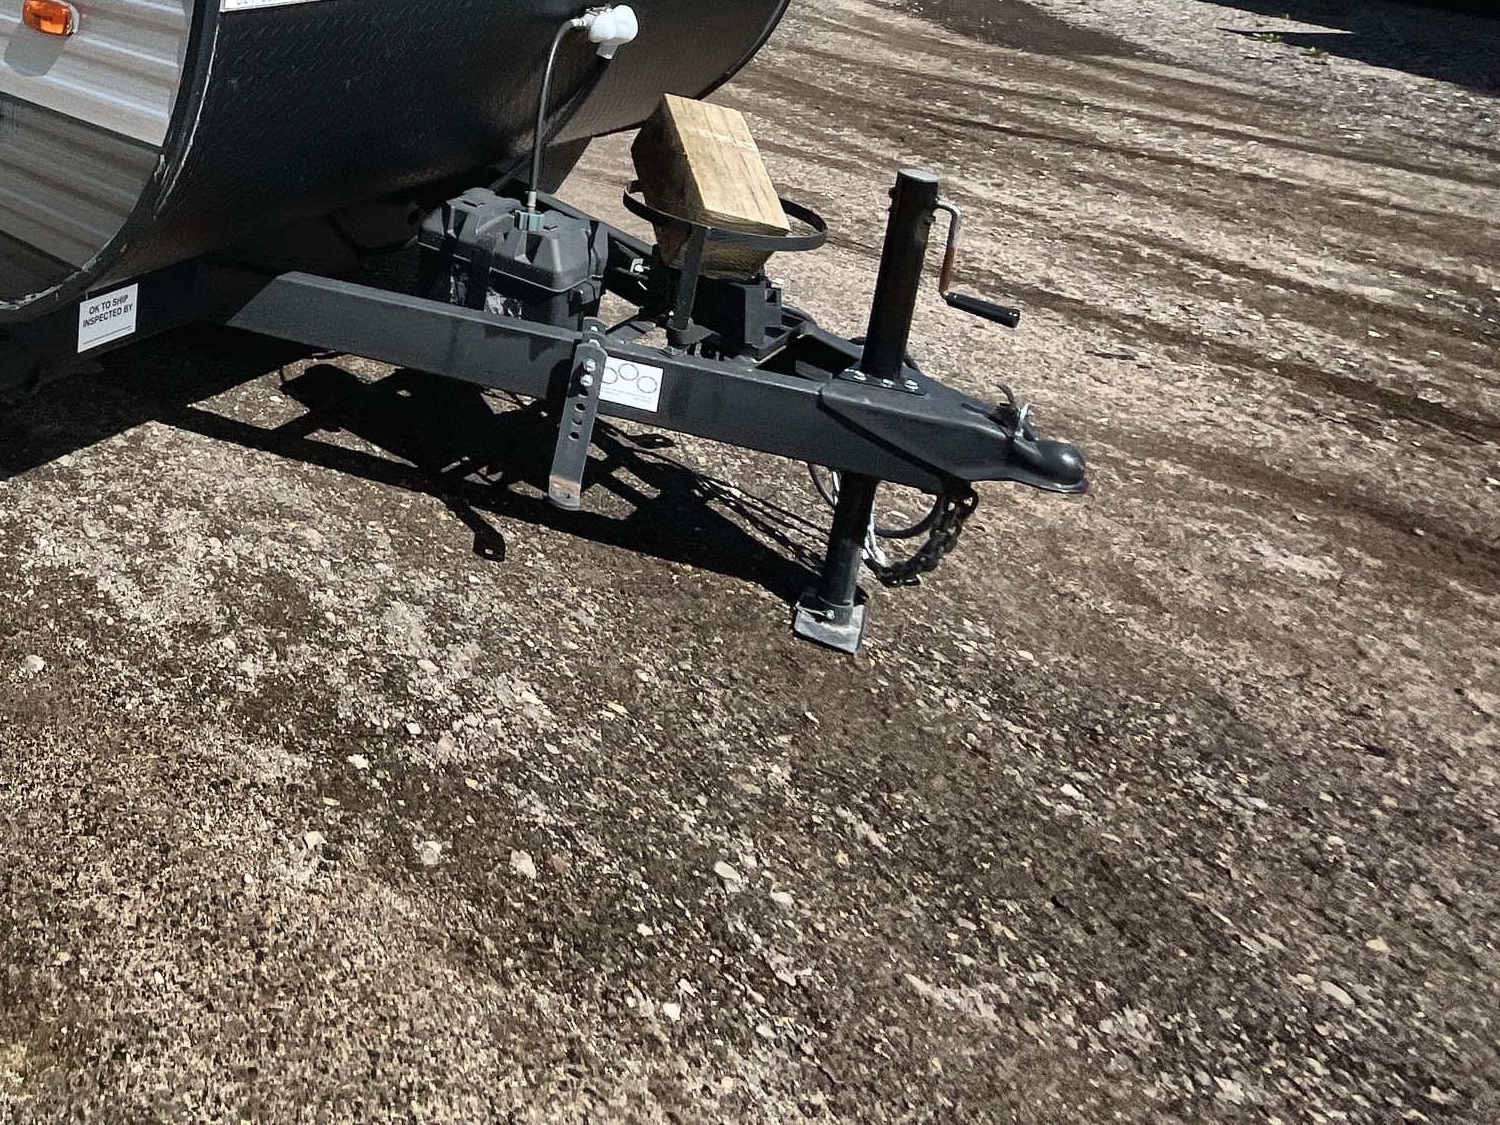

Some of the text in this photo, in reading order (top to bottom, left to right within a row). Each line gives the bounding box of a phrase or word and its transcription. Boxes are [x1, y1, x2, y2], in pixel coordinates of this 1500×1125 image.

[82, 302, 134, 328] INSPECTED BY
[88, 294, 129, 315] OK TO SHIP
